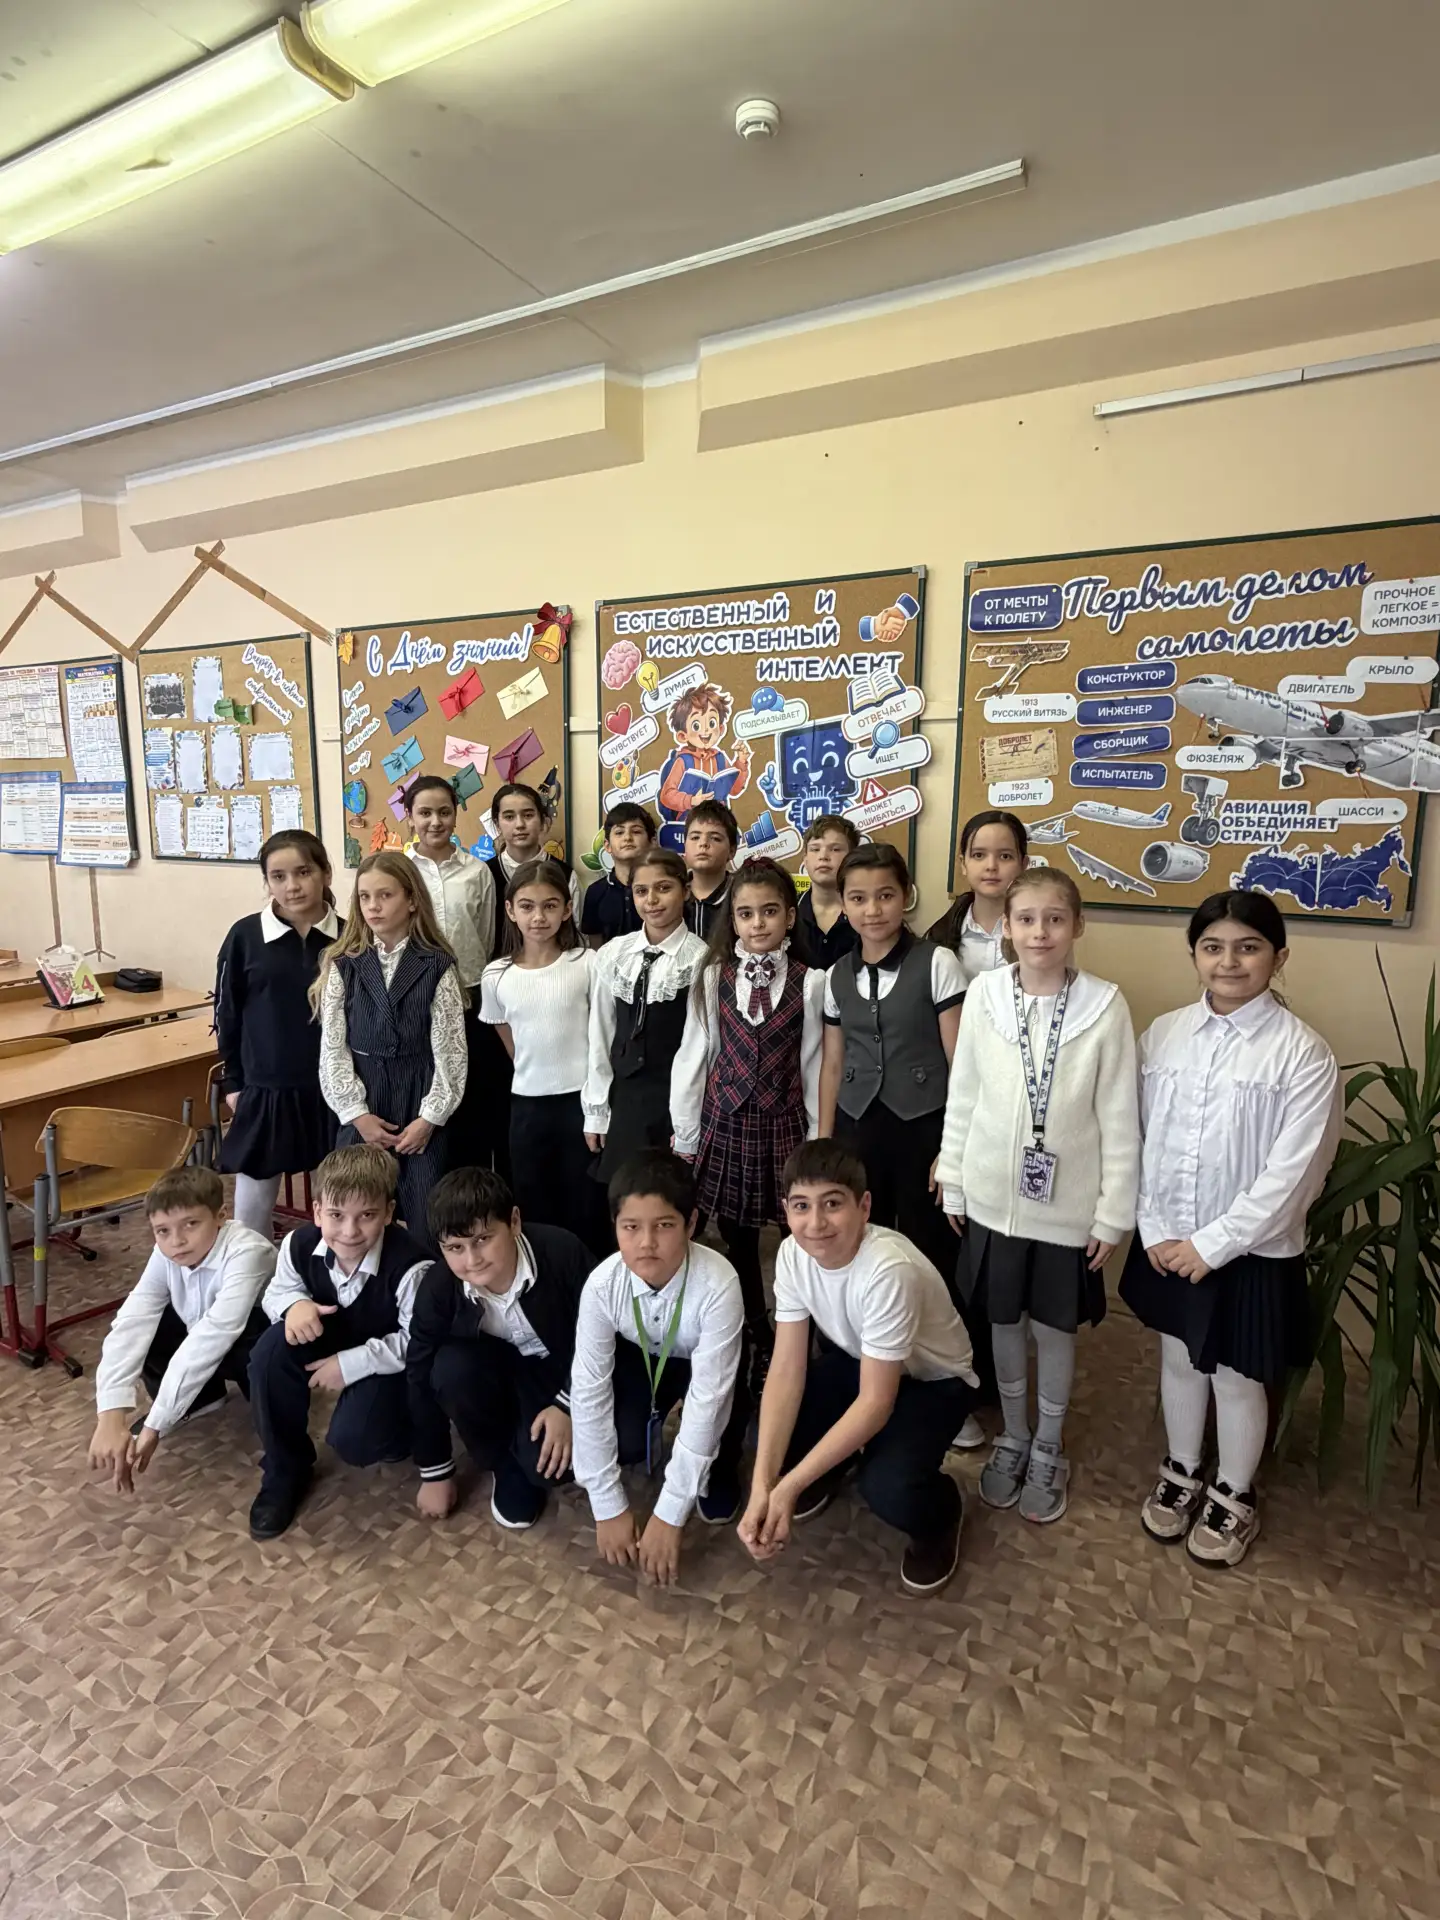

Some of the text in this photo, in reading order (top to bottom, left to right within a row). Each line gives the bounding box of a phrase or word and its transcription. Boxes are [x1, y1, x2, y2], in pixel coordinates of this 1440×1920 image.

[1065, 561, 1375, 633] Первым делом
[1374, 585, 1436, 600] ПРОЧНОЕ
[984, 595, 1048, 610] ОТ МЕЧТЫ
[1378, 600, 1428, 614] ЛЕГКОЕ
[616, 592, 833, 632] ЕСТЕСТВЕННЫЙ И
[984, 612, 1046, 625] К ПОЛЕТУ
[648, 619, 838, 656] ИСКУССТВЕННЫЙ
[1138, 620, 1355, 659] самолеты
[368, 627, 532, 674] С Днём знаний!
[759, 654, 902, 679] ИНТЕЛЛЕКТ
[1368, 664, 1414, 675] КРЫЛО
[1087, 670, 1166, 685] КОНСТРУКТОР
[663, 673, 697, 698] ДУМАЕТ
[1287, 683, 1355, 694] ДВИГАТЕЛЬ
[1021, 698, 1038, 706] 1913
[857, 699, 907, 728] ОТВЕЧАЕТ
[992, 707, 1067, 718] РУССКИЙ ВИТЯЗЬ
[1097, 704, 1153, 717] ИНЖЕНЕР
[740, 710, 801, 730] ПОДСКАЗЫВАЕТ
[608, 724, 648, 756] ЧУВСТВУЕТ
[1093, 735, 1149, 750] СБОРЩИК
[875, 752, 899, 764] ИЩЕТ
[1186, 752, 1245, 764] ФЮЗЕЛЯЖ
[1082, 769, 1154, 780] ИСПЫТАТЕЛЬ
[618, 783, 648, 803] ТВОРИТ
[1011, 782, 1029, 791] 1923
[997, 792, 1043, 802] ДОБРОЛЕТ
[864, 798, 893, 815] МОЖЕТ
[1222, 802, 1308, 815] АВИАЦИЯ
[1338, 806, 1385, 817] ШАССИ
[857, 804, 907, 829] ОШИБАТЬСЯ
[1221, 816, 1338, 830] ОБЪЕДИНЯЕТ
[1220, 829, 1289, 843] СТРАНУ
[82, 975, 95, 992] 4
